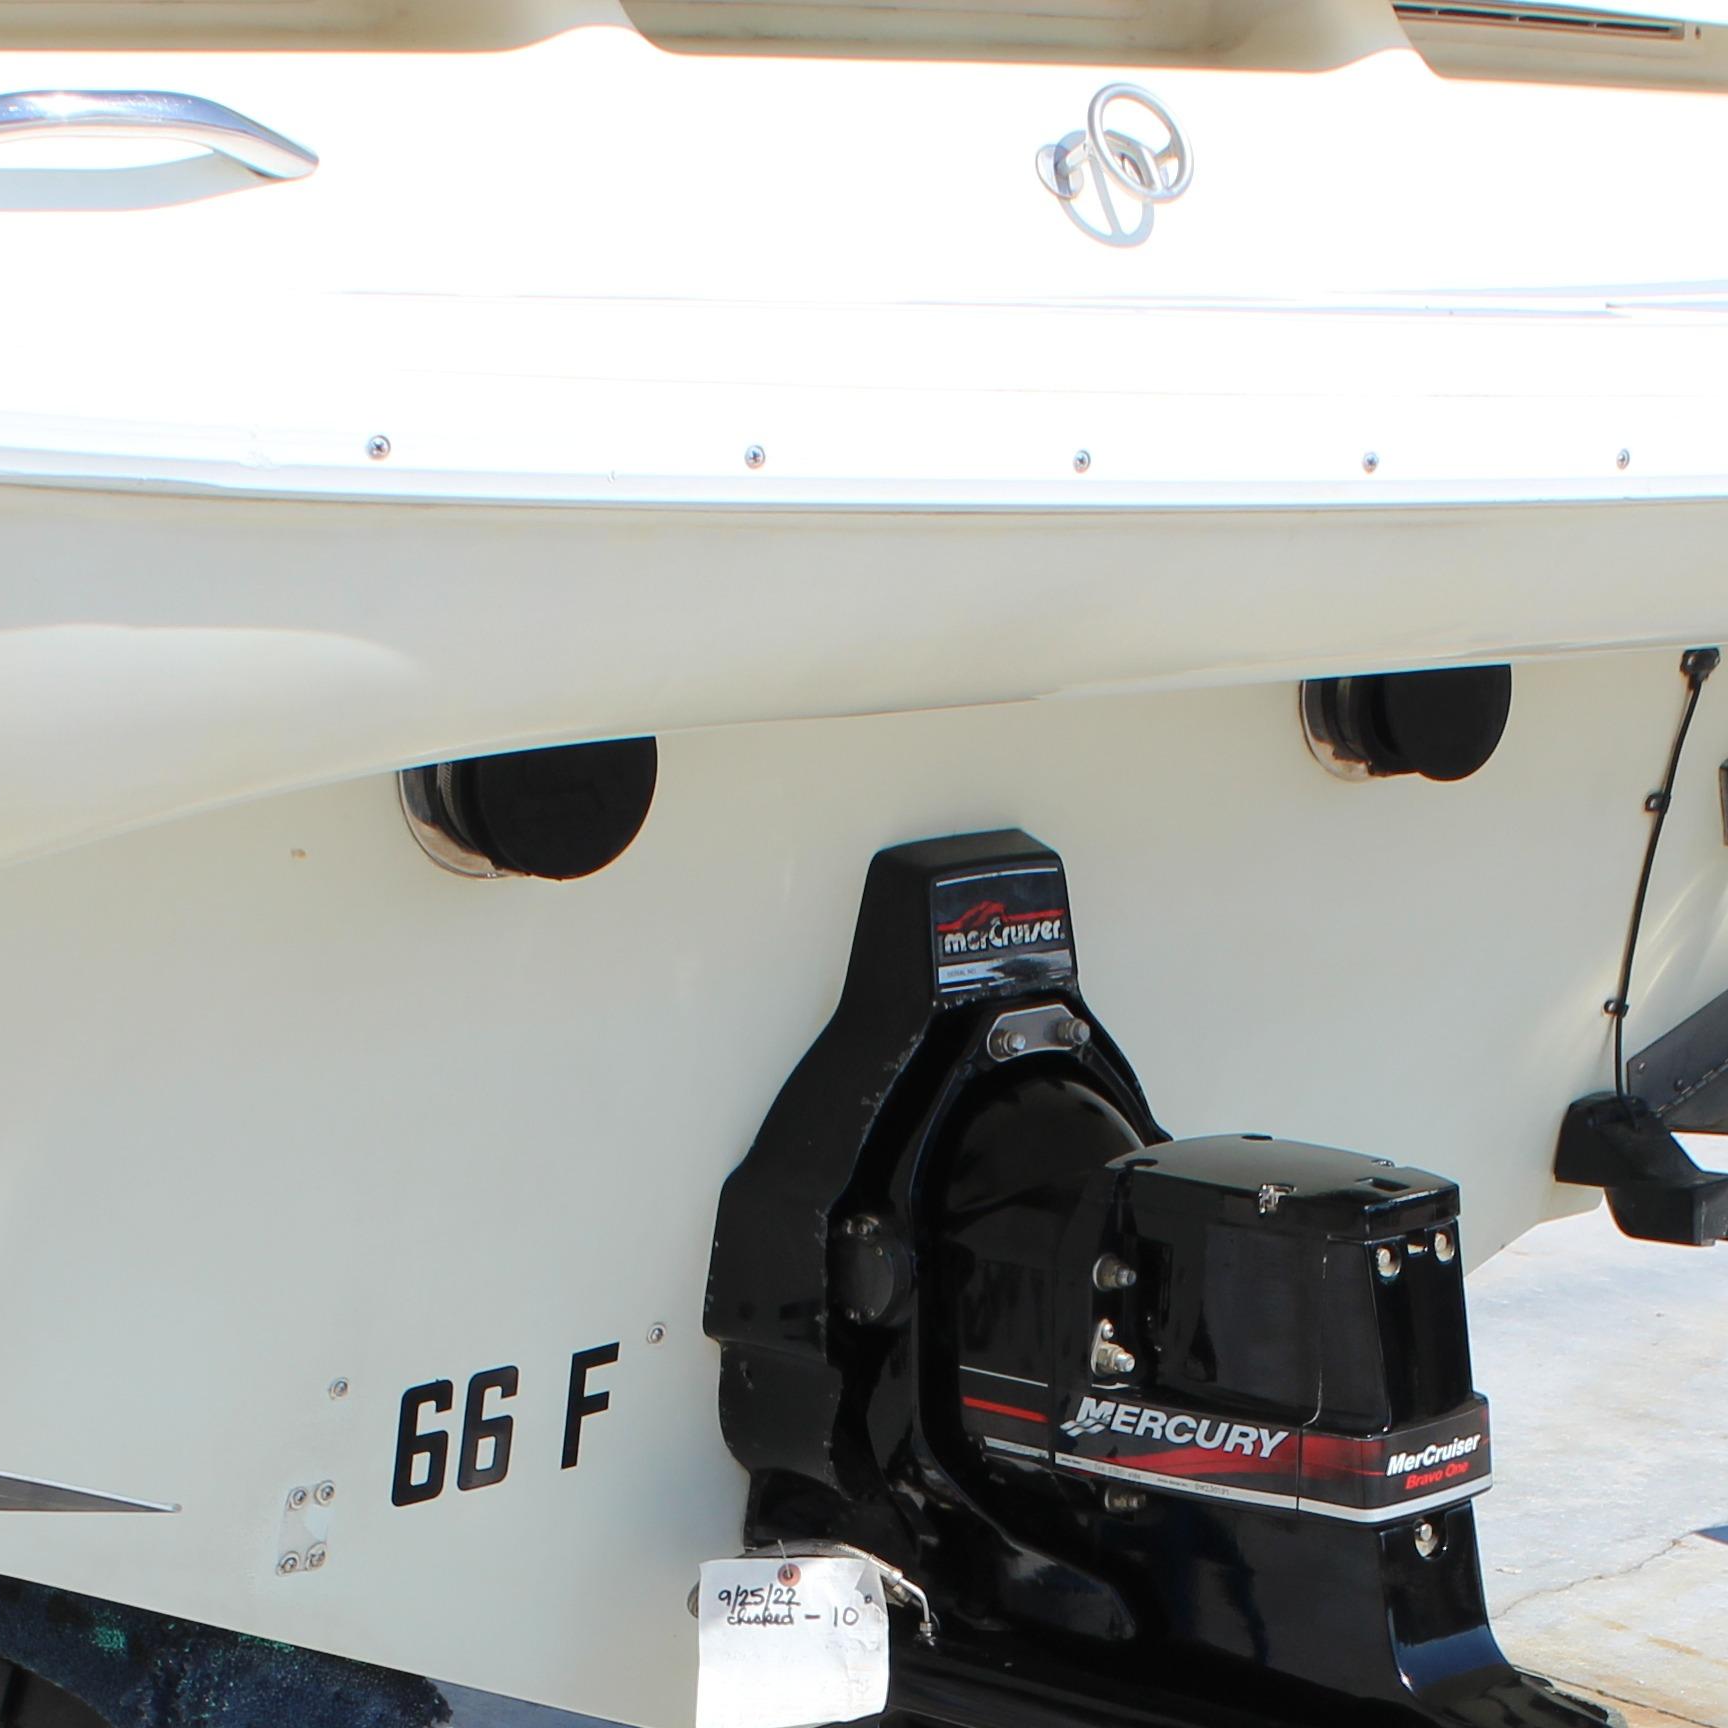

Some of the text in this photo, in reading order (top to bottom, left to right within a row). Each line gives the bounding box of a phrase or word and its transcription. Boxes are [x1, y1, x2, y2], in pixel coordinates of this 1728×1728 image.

[391, 1341, 620, 1507] 66 F
[1072, 1396, 1290, 1459] MERCURY
[1385, 1434, 1482, 1477] MerCruiser
[1405, 1461, 1470, 1490] Bravo One
[718, 1582, 802, 1615] 9/25/22
